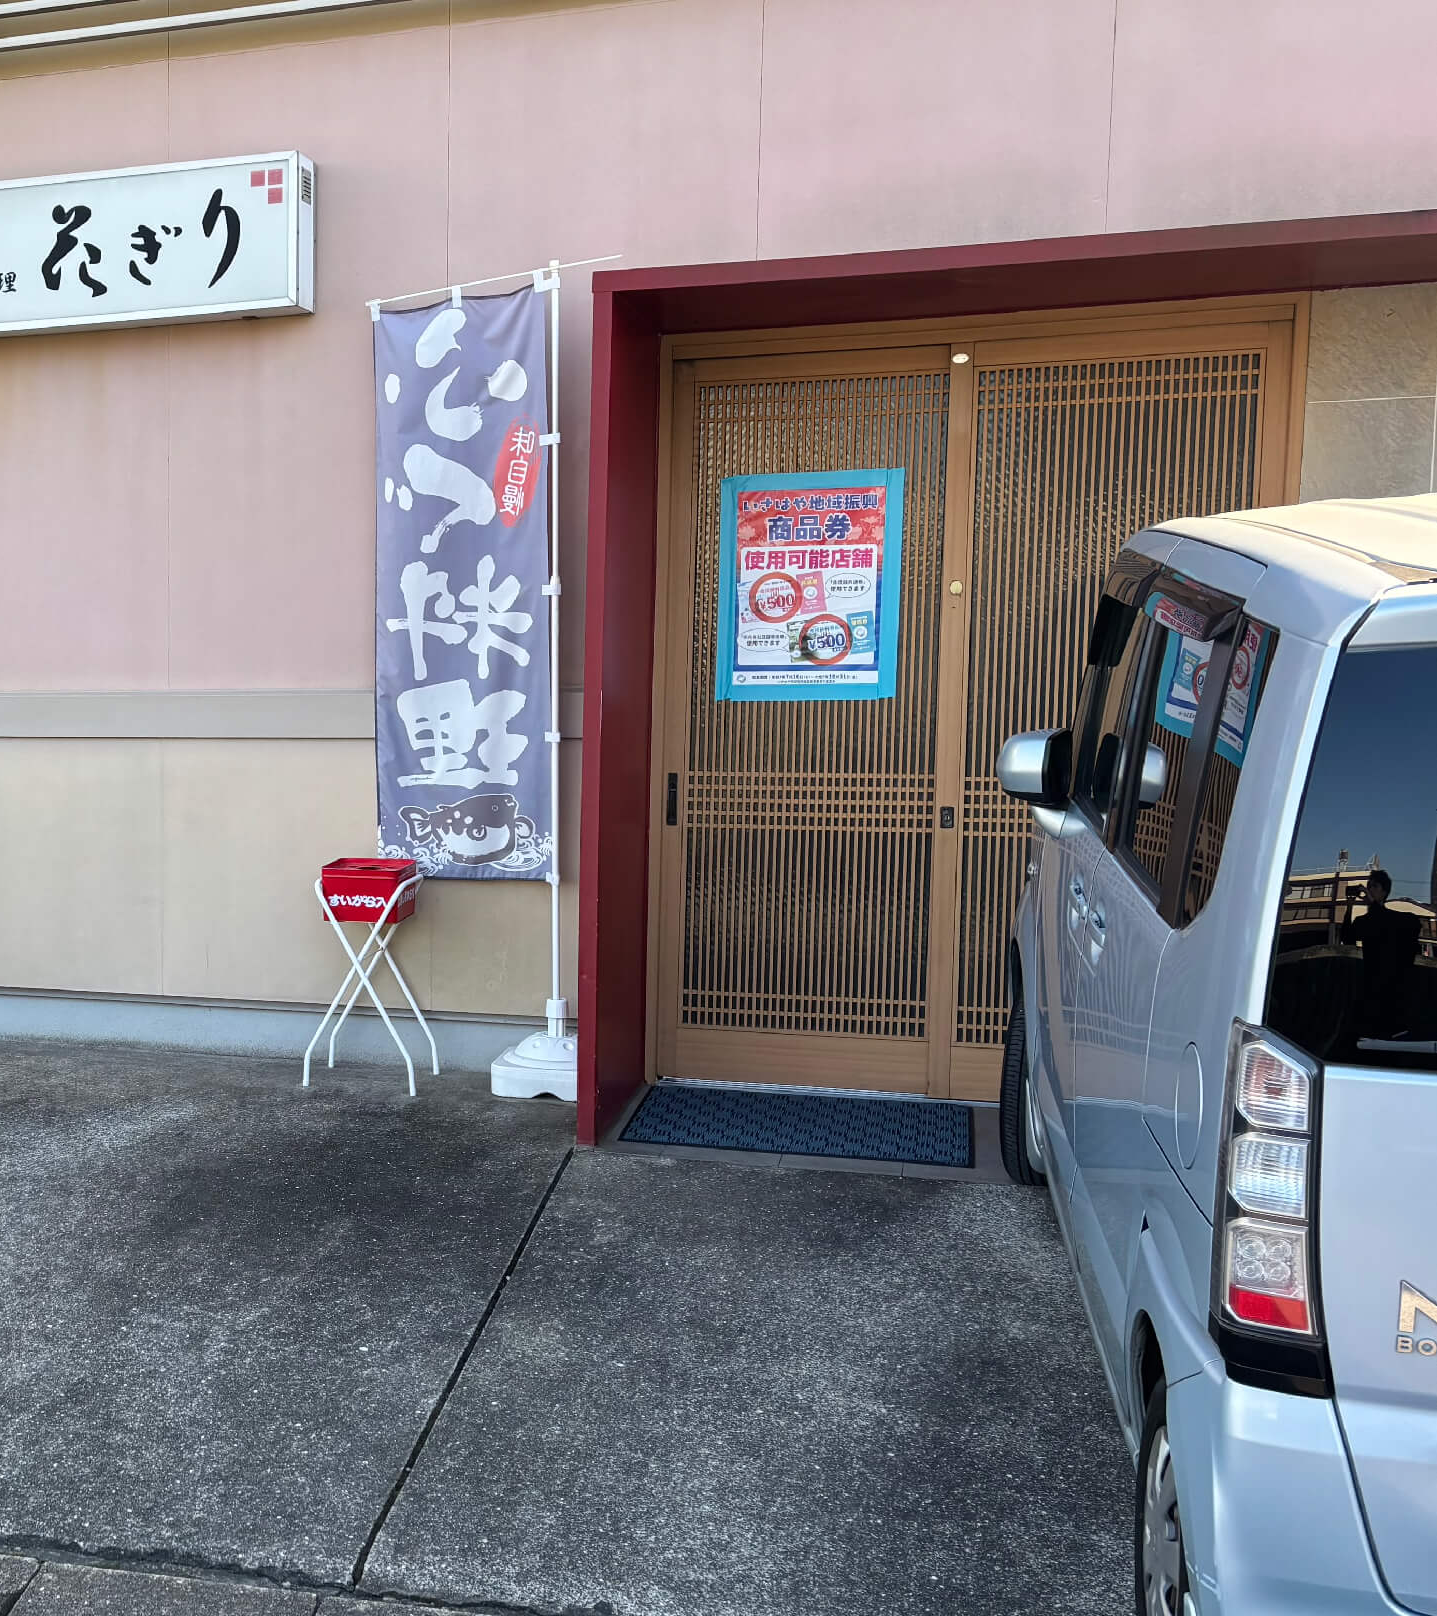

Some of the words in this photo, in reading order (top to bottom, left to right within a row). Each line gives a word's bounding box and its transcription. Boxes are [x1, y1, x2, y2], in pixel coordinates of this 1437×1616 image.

[743, 493, 879, 512] いさはや地域振興
[767, 514, 852, 541] 商品券
[744, 549, 873, 570] 使用可能店舗
[809, 633, 845, 649] ¥500
[328, 894, 388, 909] すいがら入
